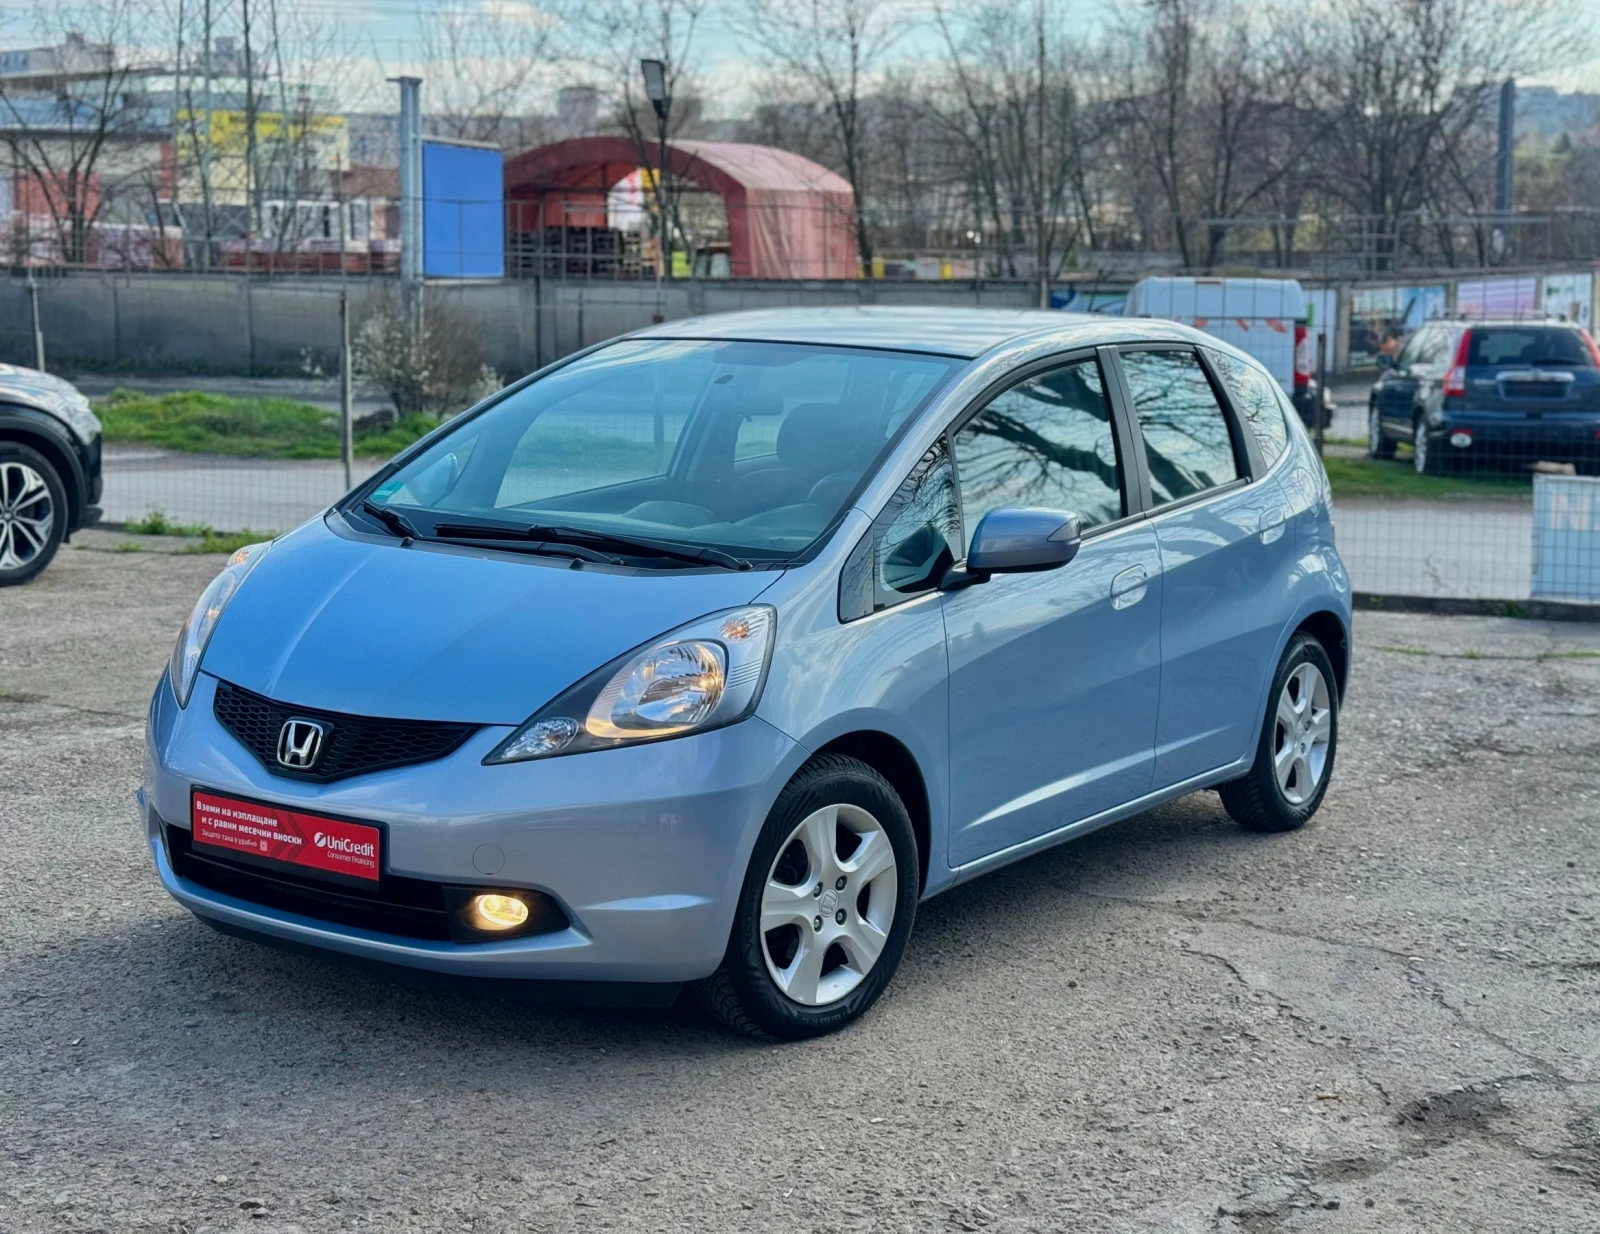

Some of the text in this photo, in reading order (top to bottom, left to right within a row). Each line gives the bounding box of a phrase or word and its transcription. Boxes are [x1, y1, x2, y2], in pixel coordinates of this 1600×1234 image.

[196, 800, 278, 827] Вземи на изплащане
[201, 816, 207, 824] и
[214, 819, 237, 831] равни
[238, 824, 272, 839] месечни
[273, 832, 302, 846] вноски
[201, 828, 221, 840] Защото
[221, 834, 234, 843] така
[238, 838, 258, 847] удобно
[327, 834, 375, 858] UniCredit
[327, 850, 375, 869] Consumer Financing
